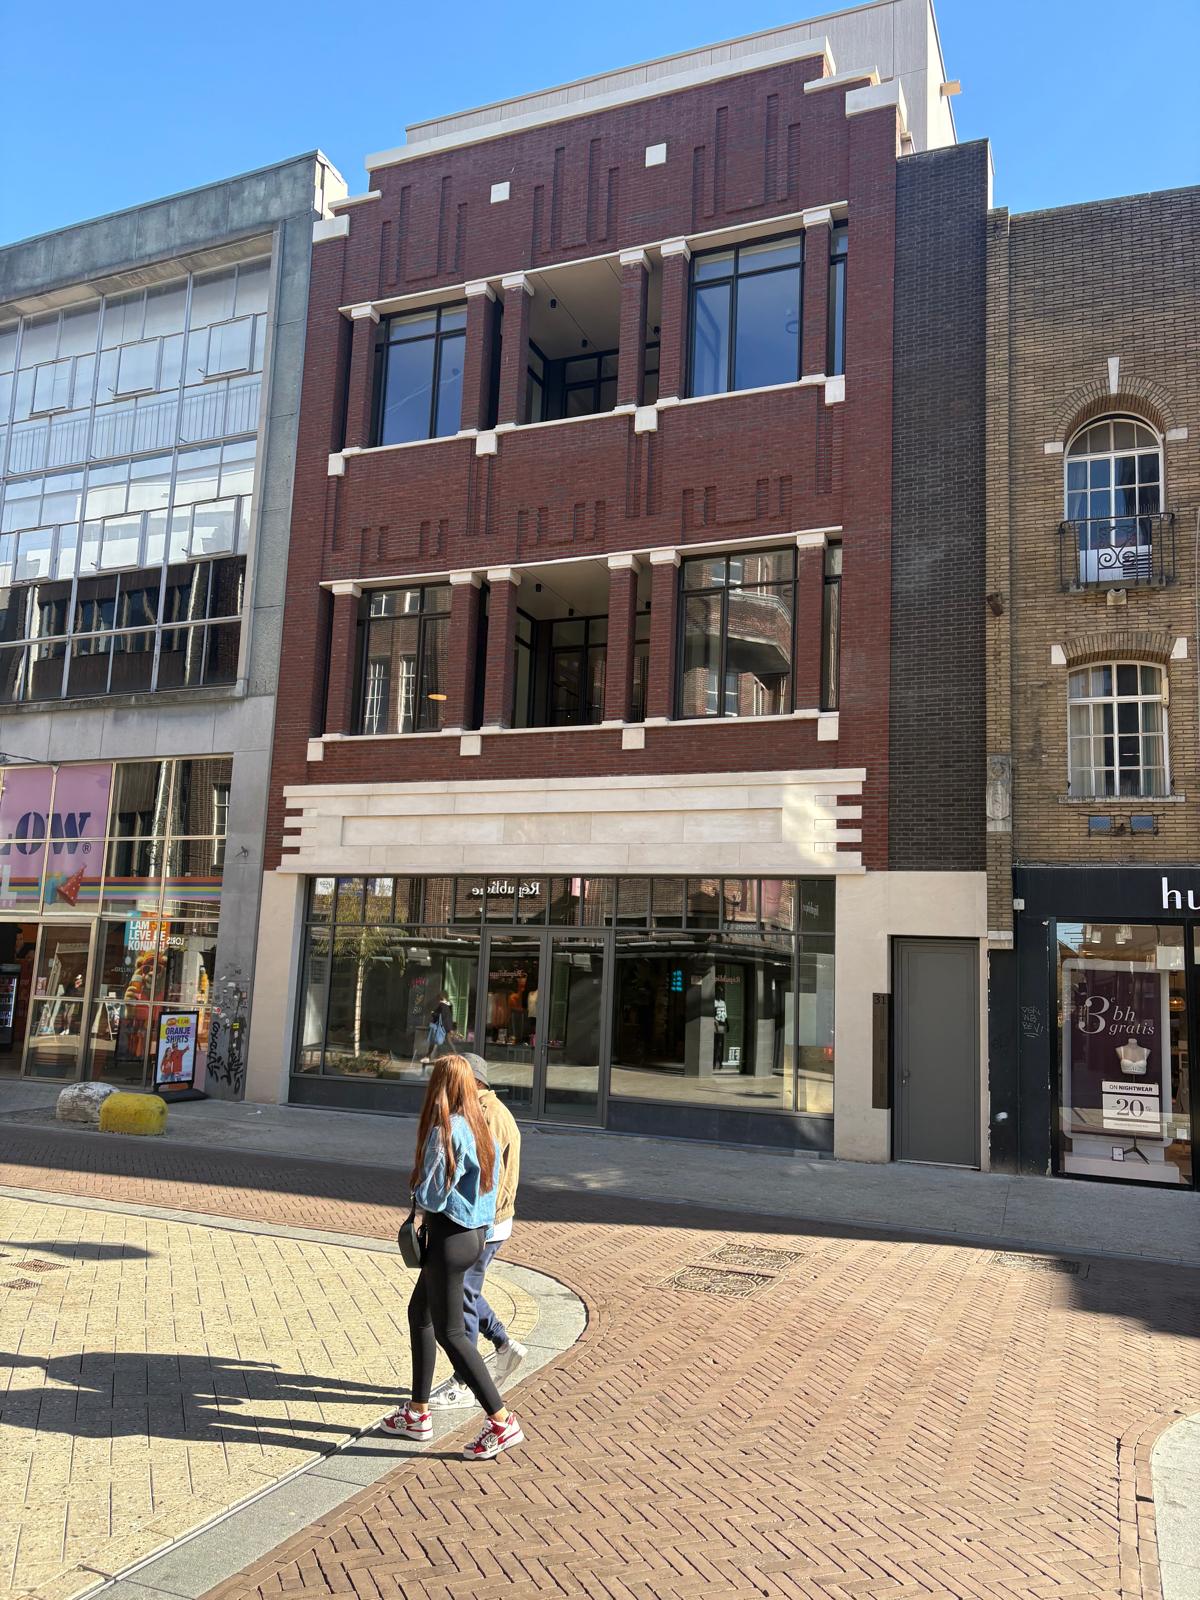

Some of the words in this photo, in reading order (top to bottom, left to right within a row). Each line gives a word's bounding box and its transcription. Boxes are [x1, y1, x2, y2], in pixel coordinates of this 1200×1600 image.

[1162, 877, 1200, 910] hu
[128, 930, 152, 941] LEVE
[874, 995, 885, 1005] 31
[1113, 1006, 1135, 1022] bh
[165, 1027, 191, 1035] ORANJE
[1109, 1023, 1155, 1035] gratis
